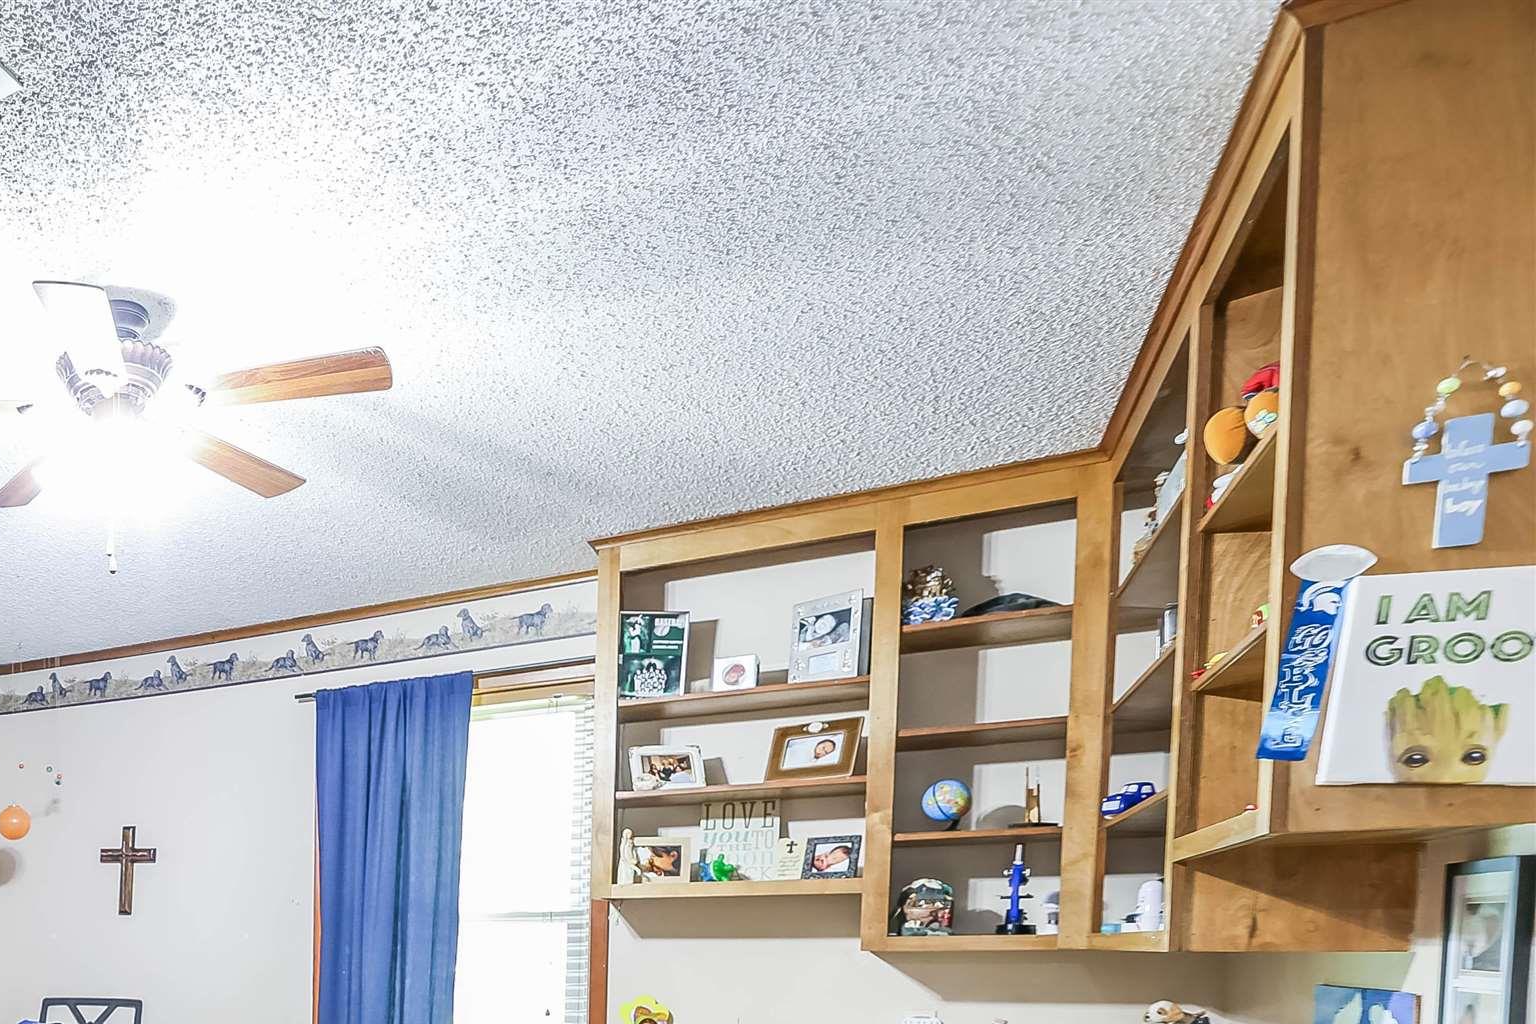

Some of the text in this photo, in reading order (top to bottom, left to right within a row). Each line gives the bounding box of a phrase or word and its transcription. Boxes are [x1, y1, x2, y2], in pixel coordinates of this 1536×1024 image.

[1376, 590, 1493, 625] I AM
[1365, 630, 1536, 667] GROO
[703, 801, 776, 831] LOVE
[704, 829, 775, 850] you TO
